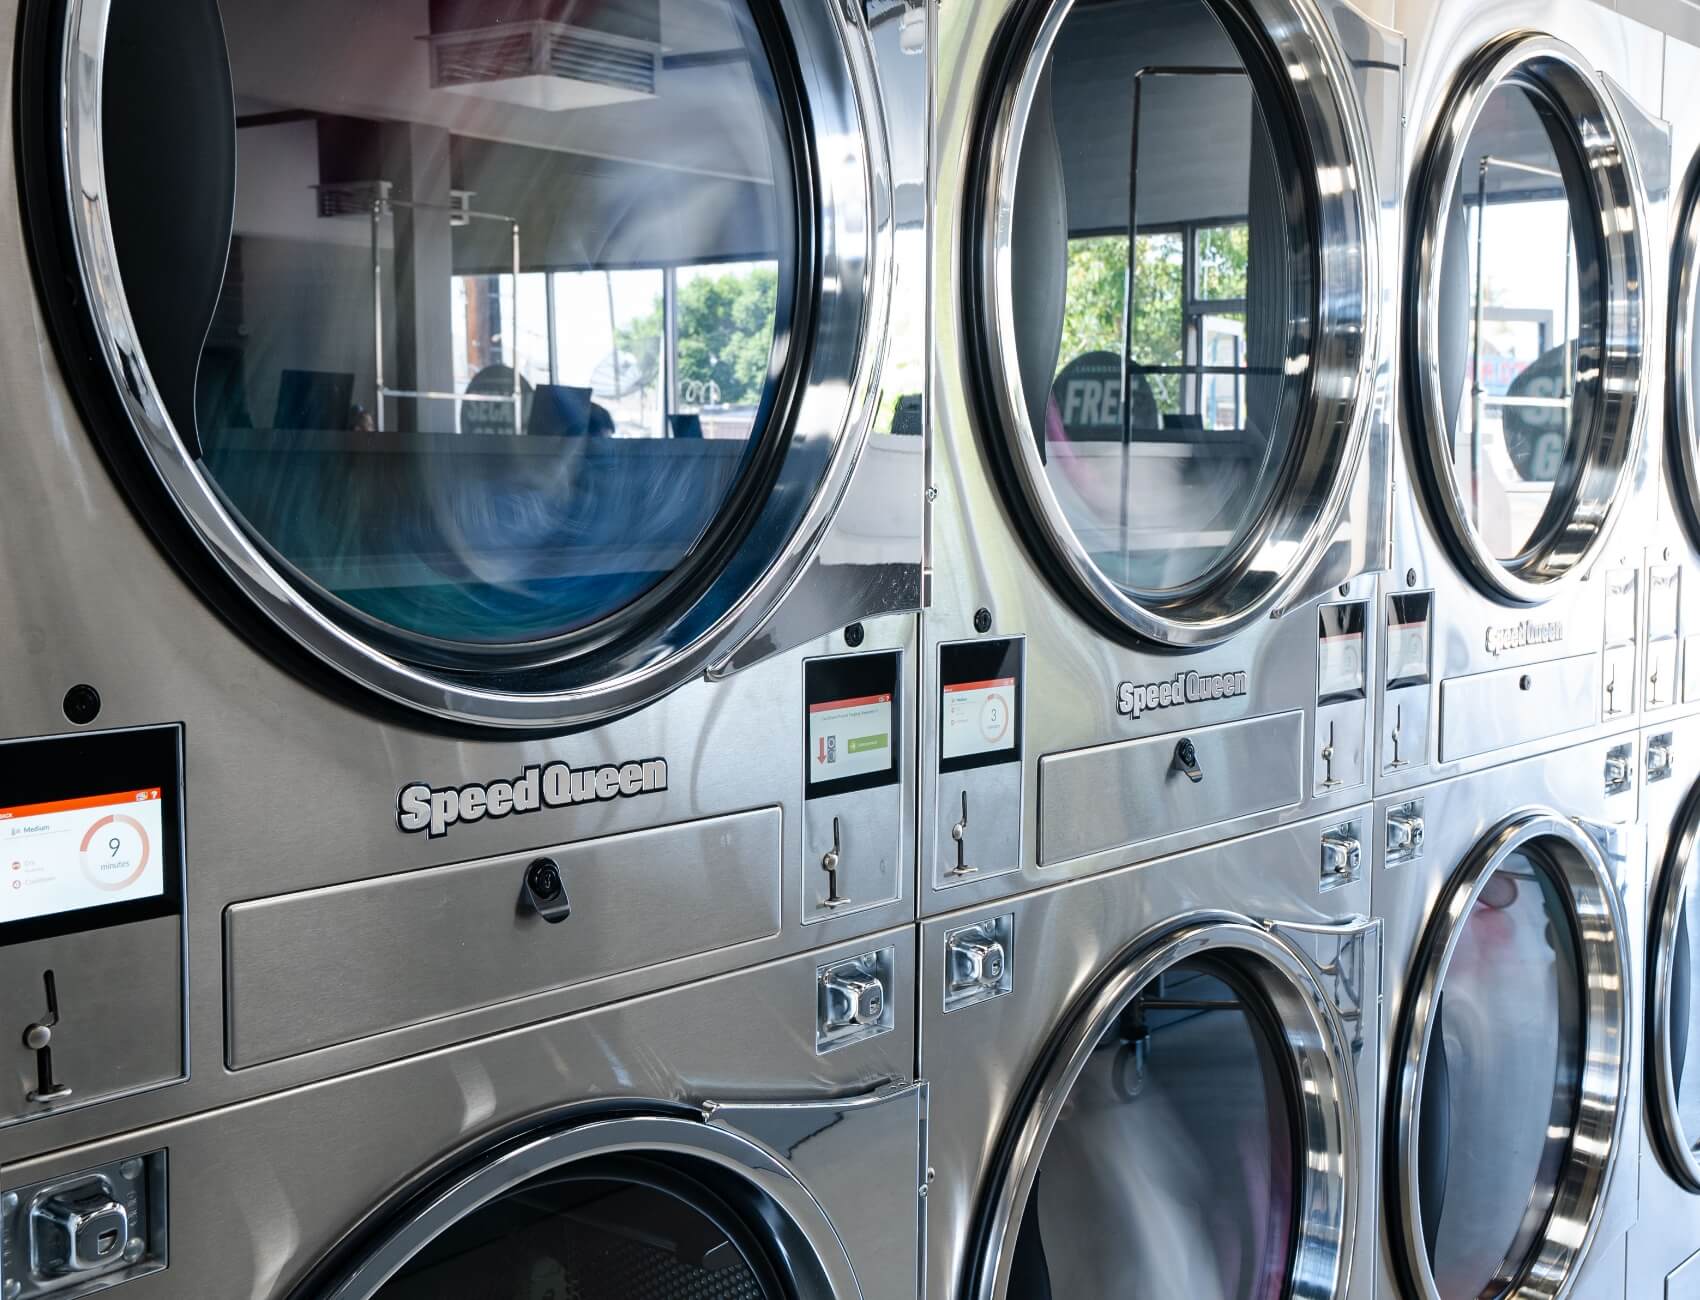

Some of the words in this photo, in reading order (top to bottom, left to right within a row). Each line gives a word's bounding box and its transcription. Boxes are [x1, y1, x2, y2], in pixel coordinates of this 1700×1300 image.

[991, 708, 998, 722] 3
[23, 824, 51, 834] Medium
[108, 837, 121, 858] 9
[100, 860, 130, 871] minutes
